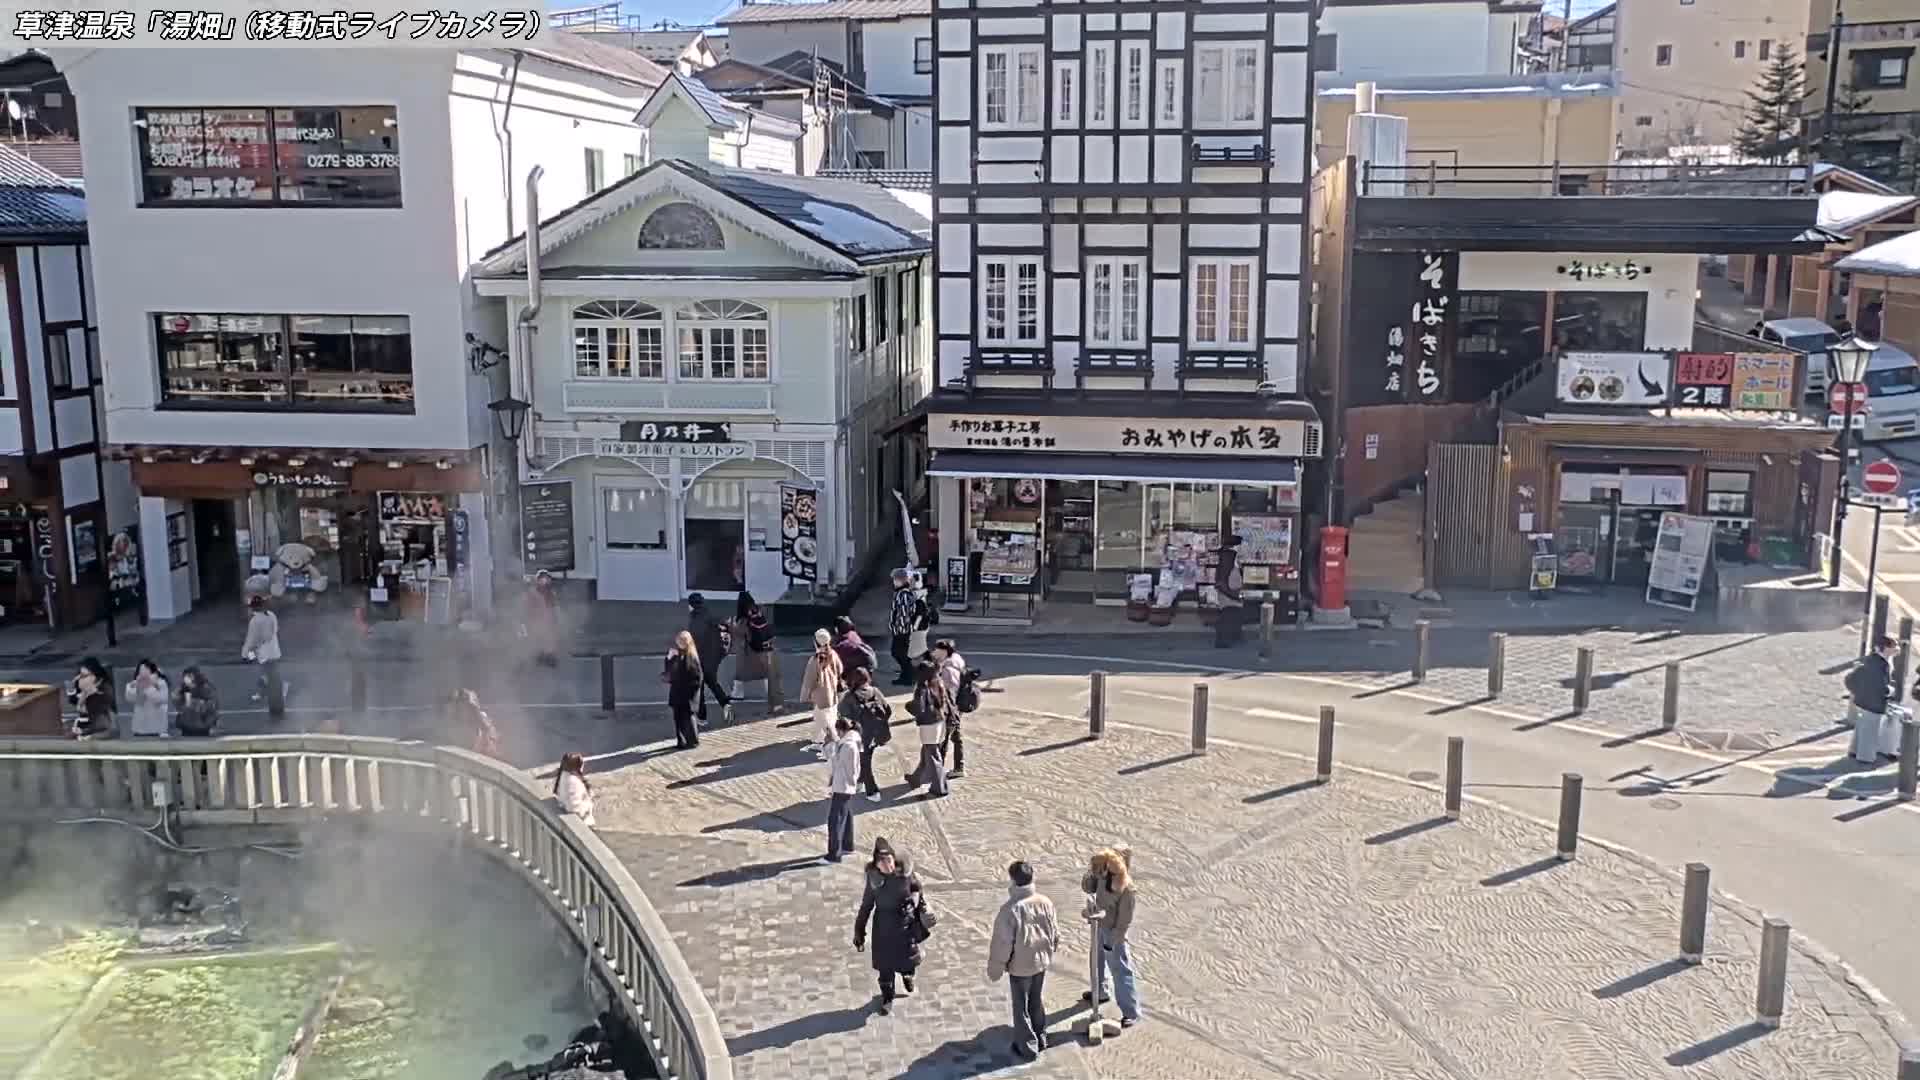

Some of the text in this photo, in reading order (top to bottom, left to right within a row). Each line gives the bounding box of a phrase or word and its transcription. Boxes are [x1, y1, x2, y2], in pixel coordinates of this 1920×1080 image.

[1568, 259, 1640, 281] そばきち
[1412, 254, 1449, 394] そばきち
[1681, 357, 1729, 380] 射的
[1682, 386, 1723, 405] 2階
[1121, 425, 1281, 449] おみやげの本多
